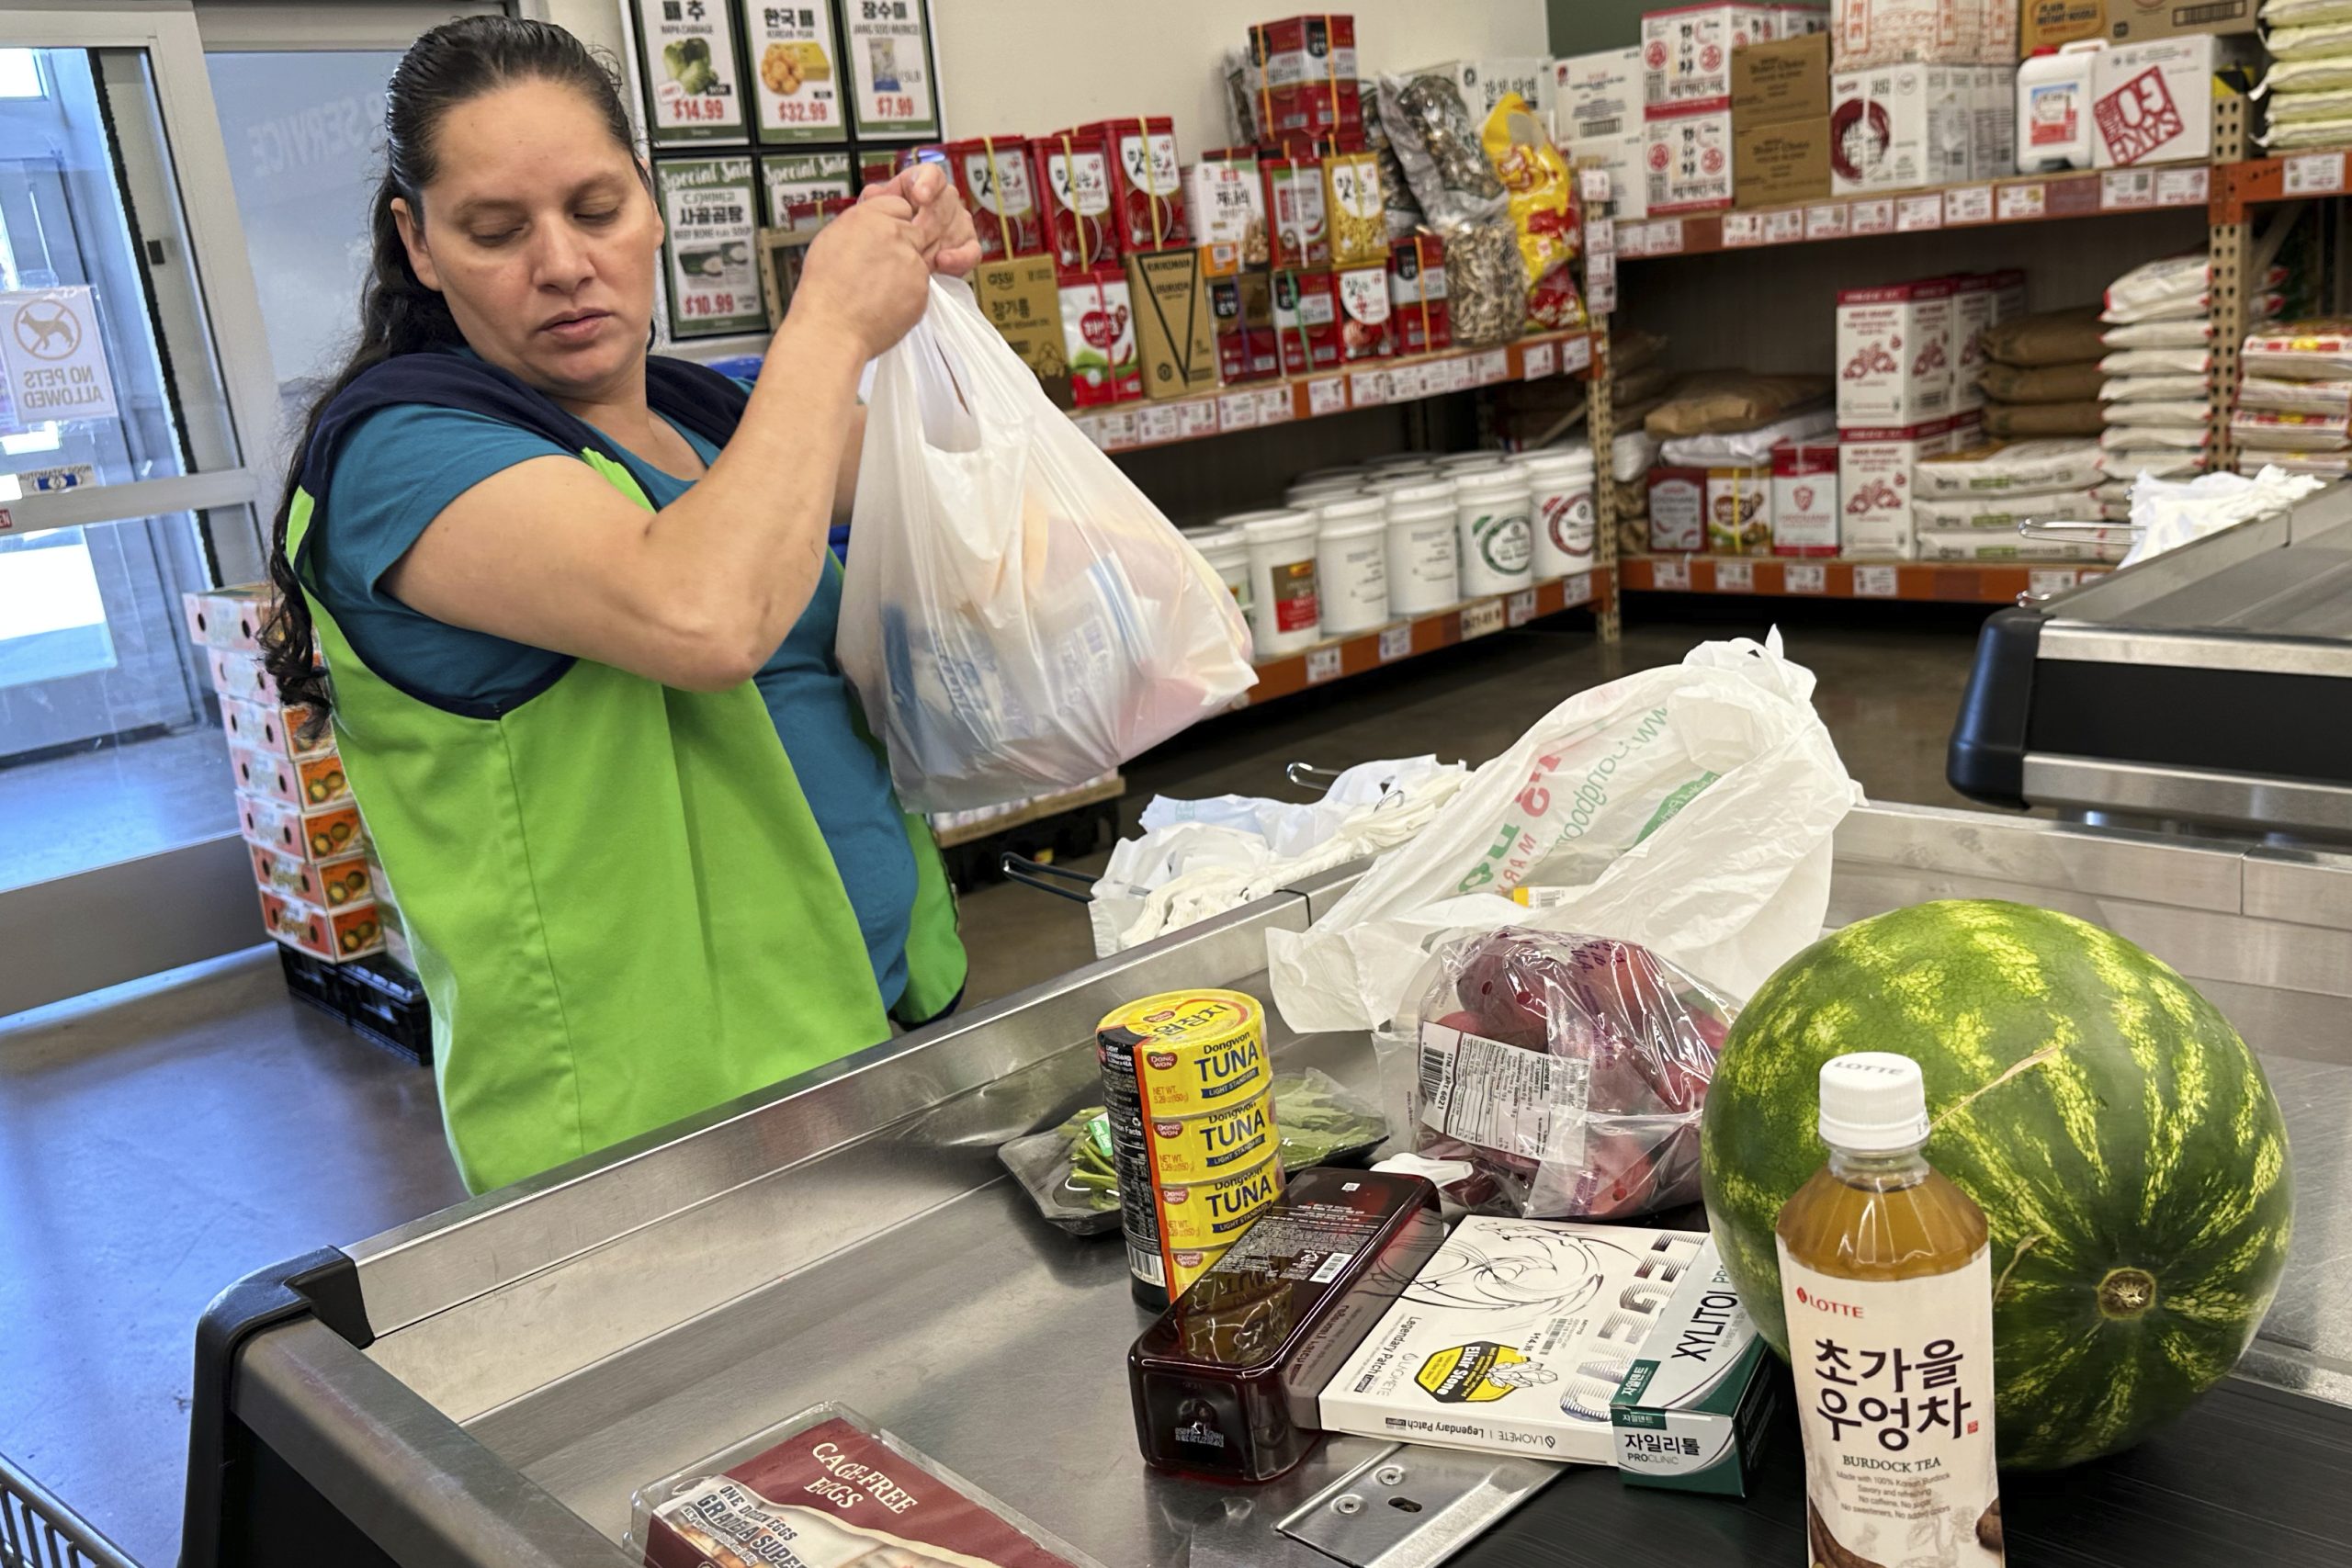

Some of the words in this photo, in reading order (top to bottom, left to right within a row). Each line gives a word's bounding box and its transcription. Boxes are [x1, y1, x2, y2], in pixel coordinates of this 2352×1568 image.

[1203, 1032, 1250, 1055] Dongwon
[1150, 1055, 1174, 1064] DONG
[1194, 1040, 1260, 1082] TUNA
[1834, 1061, 1905, 1076] LOTTE
[1209, 1085, 1227, 1096] LIGHT
[1229, 1069, 1257, 1090] STANDARD
[1442, 1077, 1451, 1093] ART.
[1208, 1101, 1257, 1123] Dongwon
[1437, 1095, 1446, 1111] 6021
[1158, 1122, 1180, 1131] DONG
[1200, 1109, 1265, 1151] TUNA
[1214, 1154, 1233, 1165] LIGHT
[1235, 1135, 1262, 1160] STANDARD
[1214, 1167, 1263, 1190] Dongwon
[1163, 1190, 1185, 1198] DONG
[1205, 1175, 1272, 1217] TUNA
[1219, 1219, 1238, 1231] LIGHT
[1177, 1253, 1200, 1262] DONG
[1810, 1294, 1864, 1319] LOTTE
[1384, 1317, 1421, 1354] Legendary
[1368, 1352, 1393, 1375] Patch
[1458, 1347, 1480, 1368] Elixir
[1815, 1338, 1963, 1393] 초가을
[1436, 1370, 1467, 1396] Stone
[1408, 1421, 1433, 1432] Patch
[1816, 1386, 1972, 1451] 우엉차
[1435, 1424, 1484, 1438] Legendary
[1624, 1433, 1700, 1456] 자일리톨
[1628, 1453, 1679, 1465] PROCLINIC
[1843, 1455, 1912, 1472] BURDOCK
[1915, 1457, 1941, 1472] TEA
[812, 1442, 918, 1516] CAGE-FREE
[1874, 1477, 1894, 1485] 100%
[804, 1476, 864, 1508] EGGS
[1859, 1495, 1869, 1504] No
[697, 1495, 750, 1531] GRADE
[740, 1526, 761, 1540] A
[719, 1485, 745, 1506] ONE
[766, 1518, 797, 1540] EGGS
[1841, 1503, 1851, 1511] No
[1894, 1510, 1905, 1518] No
